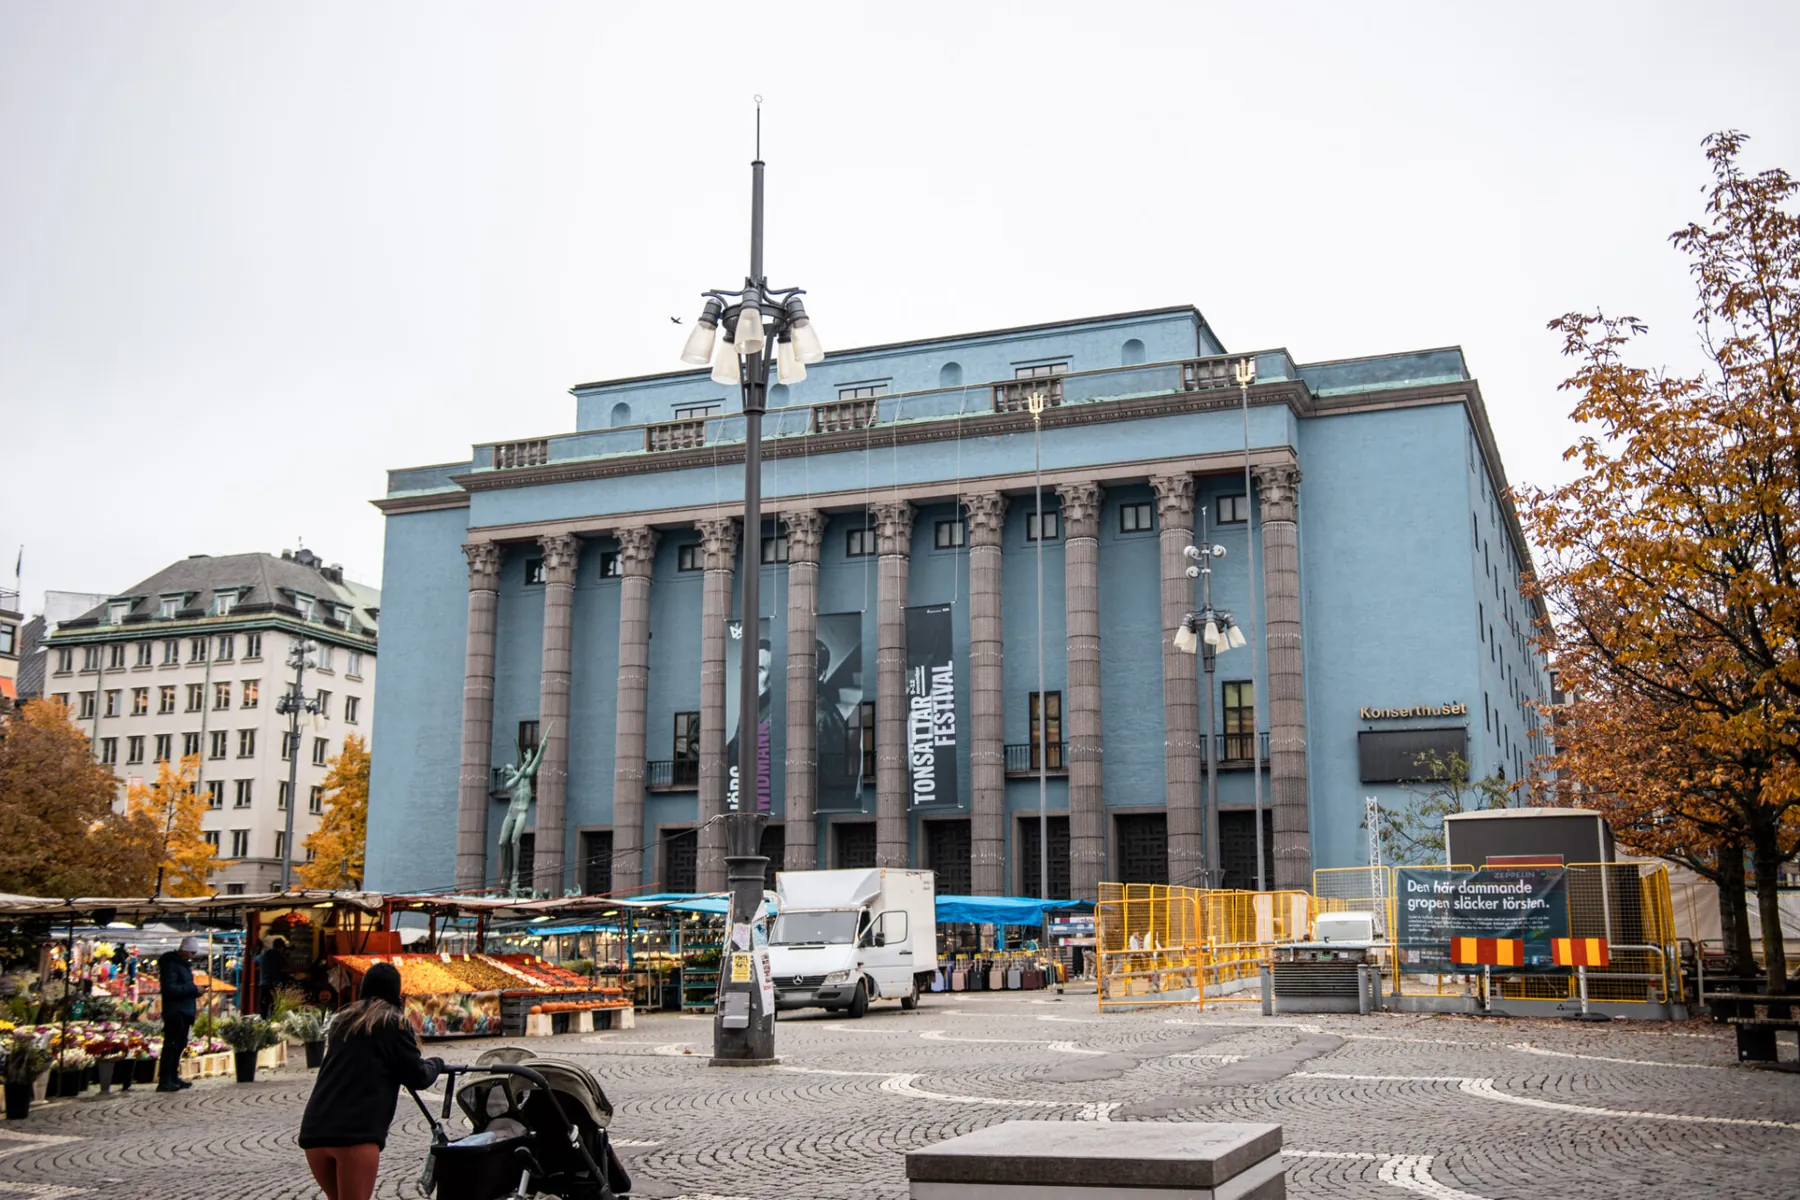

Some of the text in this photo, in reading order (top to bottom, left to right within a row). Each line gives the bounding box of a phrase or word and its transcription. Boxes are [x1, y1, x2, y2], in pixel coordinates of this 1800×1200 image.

[931, 660, 955, 746] FESTIVAL
[1360, 703, 1467, 719] Konserthuset
[910, 696, 936, 805] TONSÄTTAR
[1407, 879, 1532, 894] Den här dammande
[1407, 895, 1550, 912] gropen släcker törsten.
